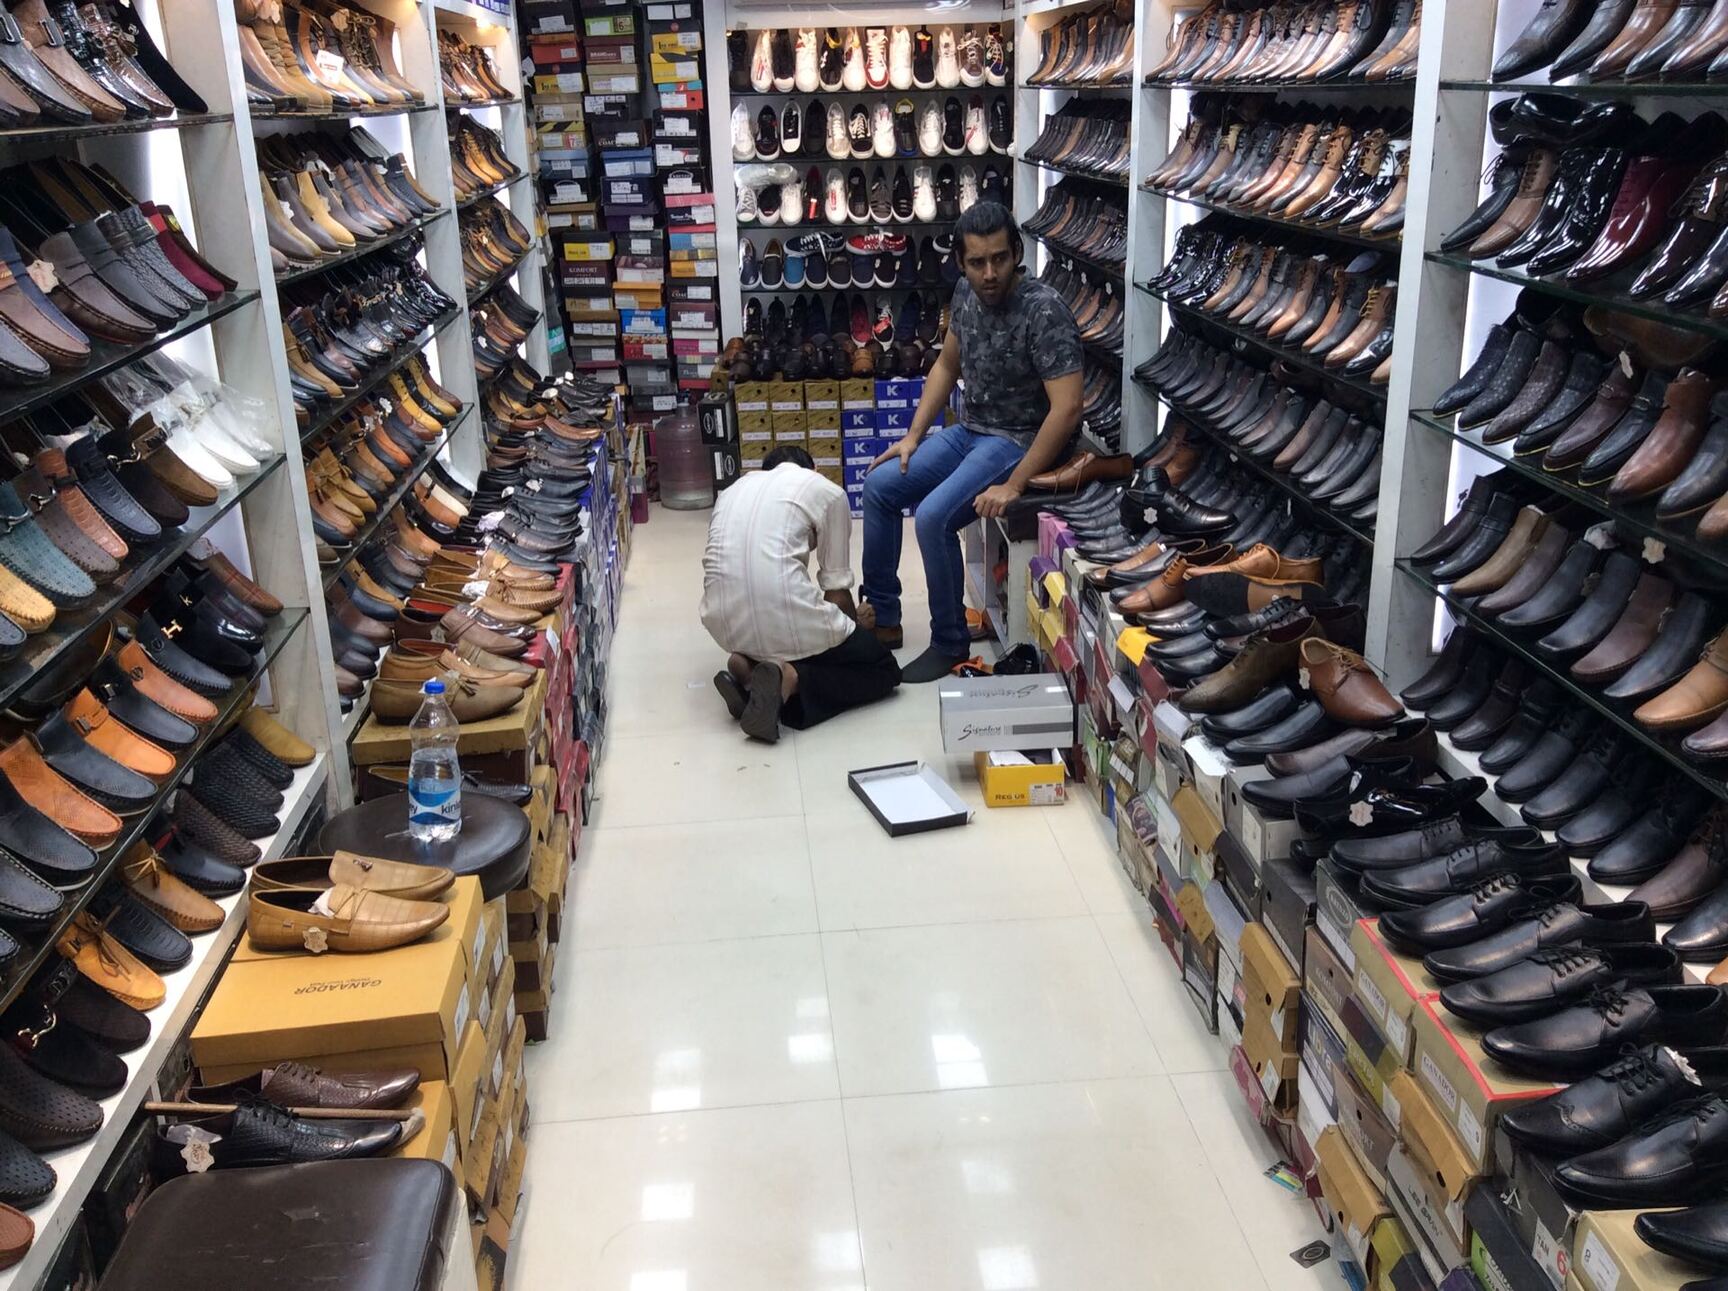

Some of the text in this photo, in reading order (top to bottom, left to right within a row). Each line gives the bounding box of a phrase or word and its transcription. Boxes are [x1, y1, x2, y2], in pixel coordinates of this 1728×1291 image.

[886, 385, 898, 396] K
[853, 414, 864, 425] K
[887, 414, 899, 425] K
[854, 442, 866, 454] K
[855, 469, 866, 481] K
[958, 724, 1001, 741] Signature
[293, 979, 382, 995] GANAADOR
[1536, 1234, 1550, 1256] TAN
